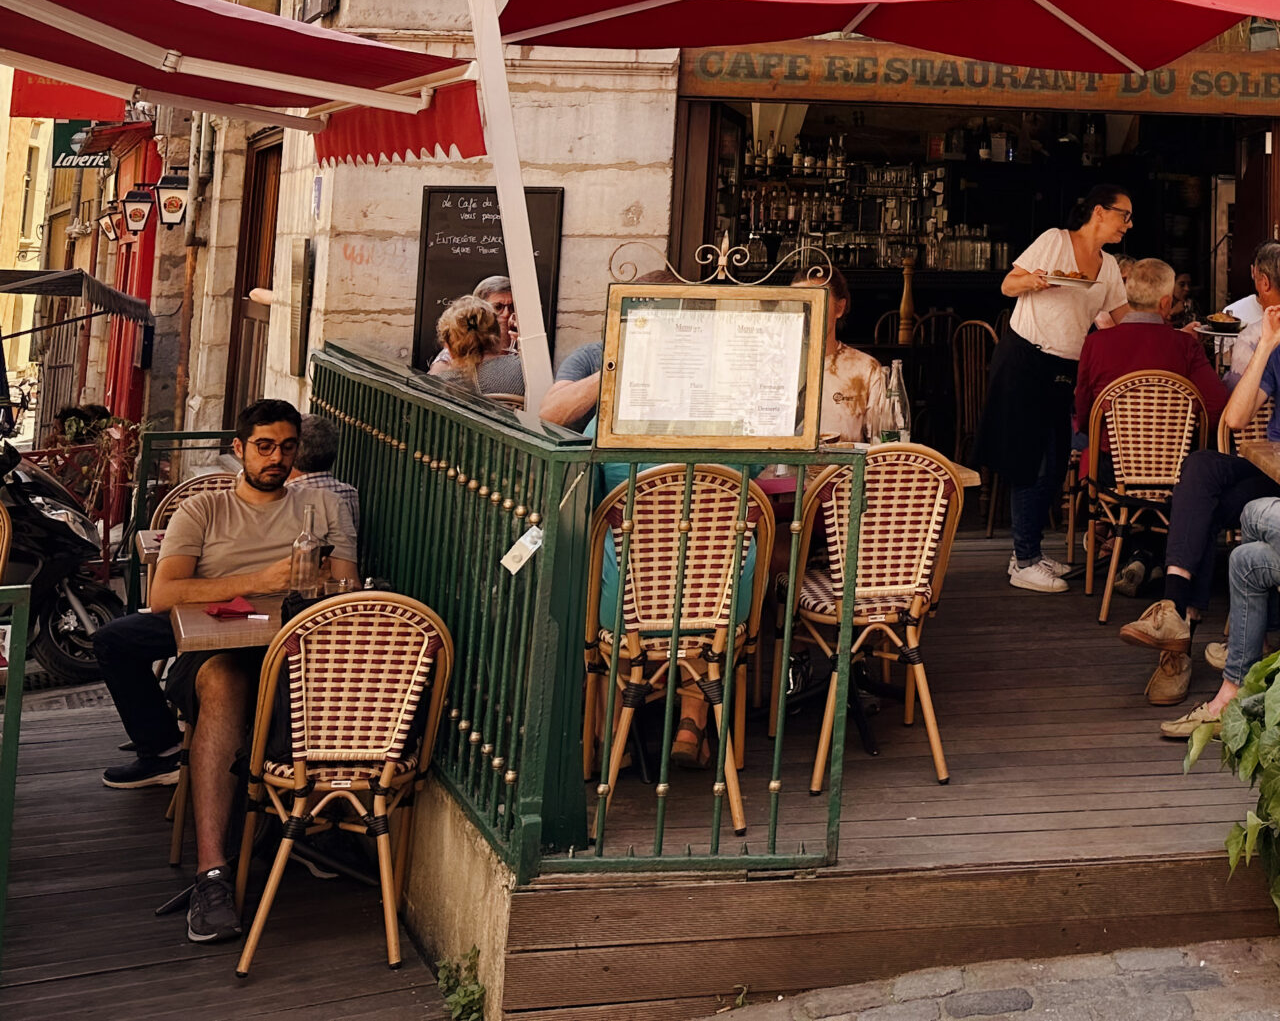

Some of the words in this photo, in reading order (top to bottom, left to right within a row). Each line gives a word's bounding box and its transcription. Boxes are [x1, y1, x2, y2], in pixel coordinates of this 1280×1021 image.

[696, 50, 811, 83] CAFE
[824, 55, 1104, 94] RESTAURANT
[1119, 68, 1176, 95] DU
[55, 152, 109, 167] Laverie
[482, 197, 492, 208] du
